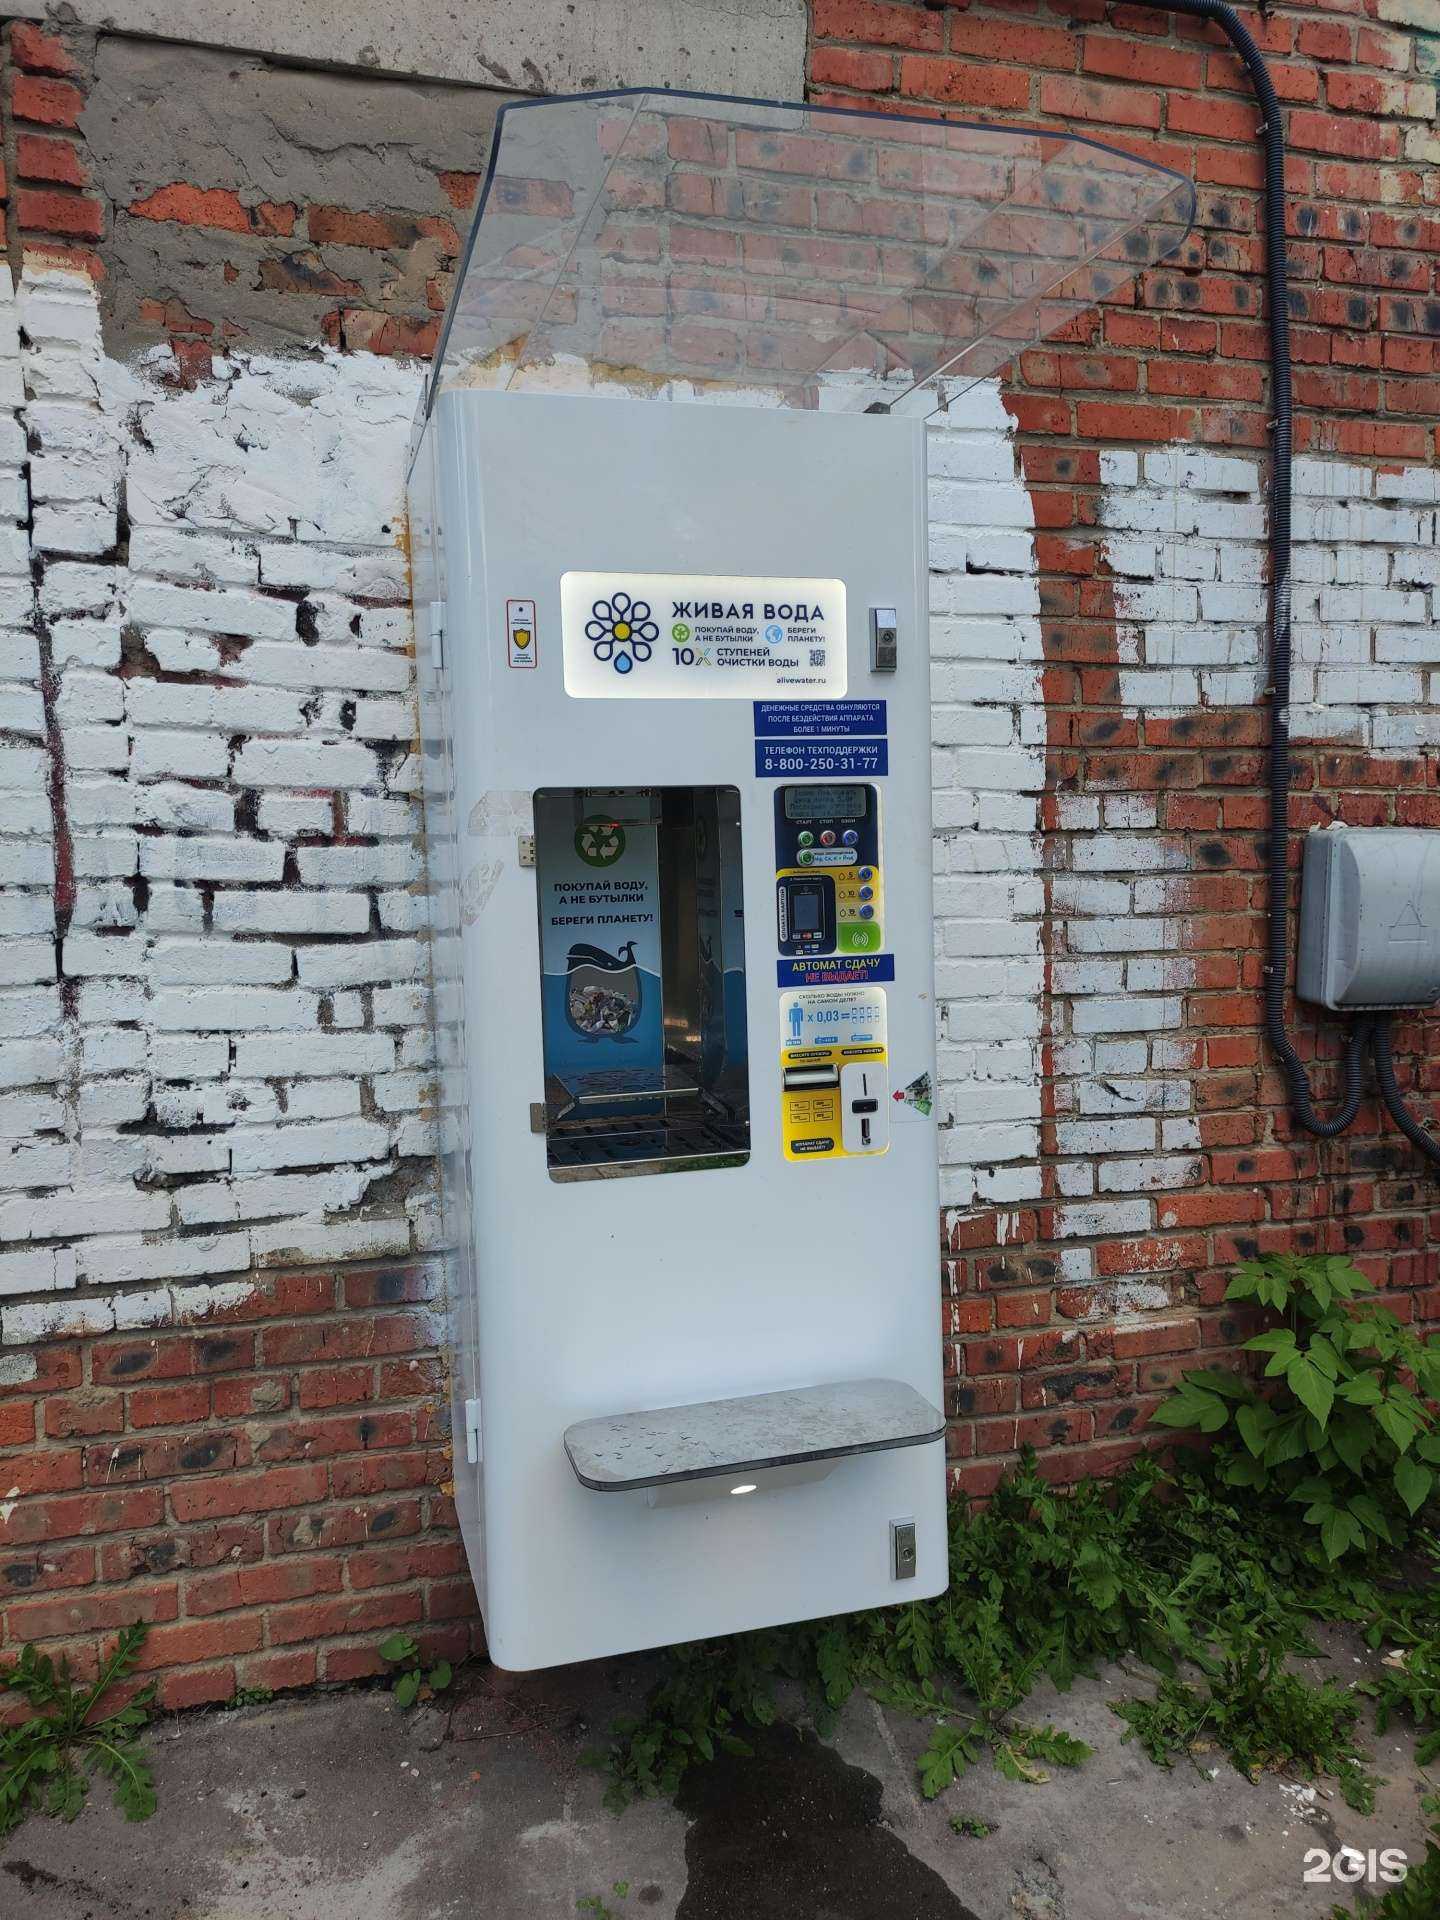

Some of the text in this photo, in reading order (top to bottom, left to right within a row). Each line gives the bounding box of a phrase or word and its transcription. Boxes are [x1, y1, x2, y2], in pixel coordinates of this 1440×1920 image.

[672, 602, 824, 622] ЖИВАЯ ВОДА
[695, 626, 759, 635] ПОКУПАЙ ВОДУ,
[717, 648, 770, 657] СТУПЕНЕЙ
[717, 658, 799, 668] ОЧИСТКИ ВОДЫ
[761, 703, 880, 712] ДЕНЕЖНЫЕ СРЕДСТВА ОБНУЛЯЮТСЯ
[768, 714, 874, 723] ПОСЛЕ БЕЗДЕЙСТВИЯ АППАРАТА
[821, 725, 850, 733] МИНУТЫ
[764, 746, 878, 755] ТЕЛЕФОН ТЕХПОДДЕРЖКИ
[764, 757, 878, 770] 8-800-250-31-77
[554, 881, 648, 892] ПОКУПАЙ ВОДУ,
[559, 894, 644, 905] А НЕ БУТЫЛКИ
[551, 914, 654, 926] БЕРЕГИ ПЛАНЕТУ!
[792, 958, 880, 972] АВТОМАТ СДАЧУ
[805, 973, 820, 982] НЕ
[816, 1010, 839, 1023] 0,03
